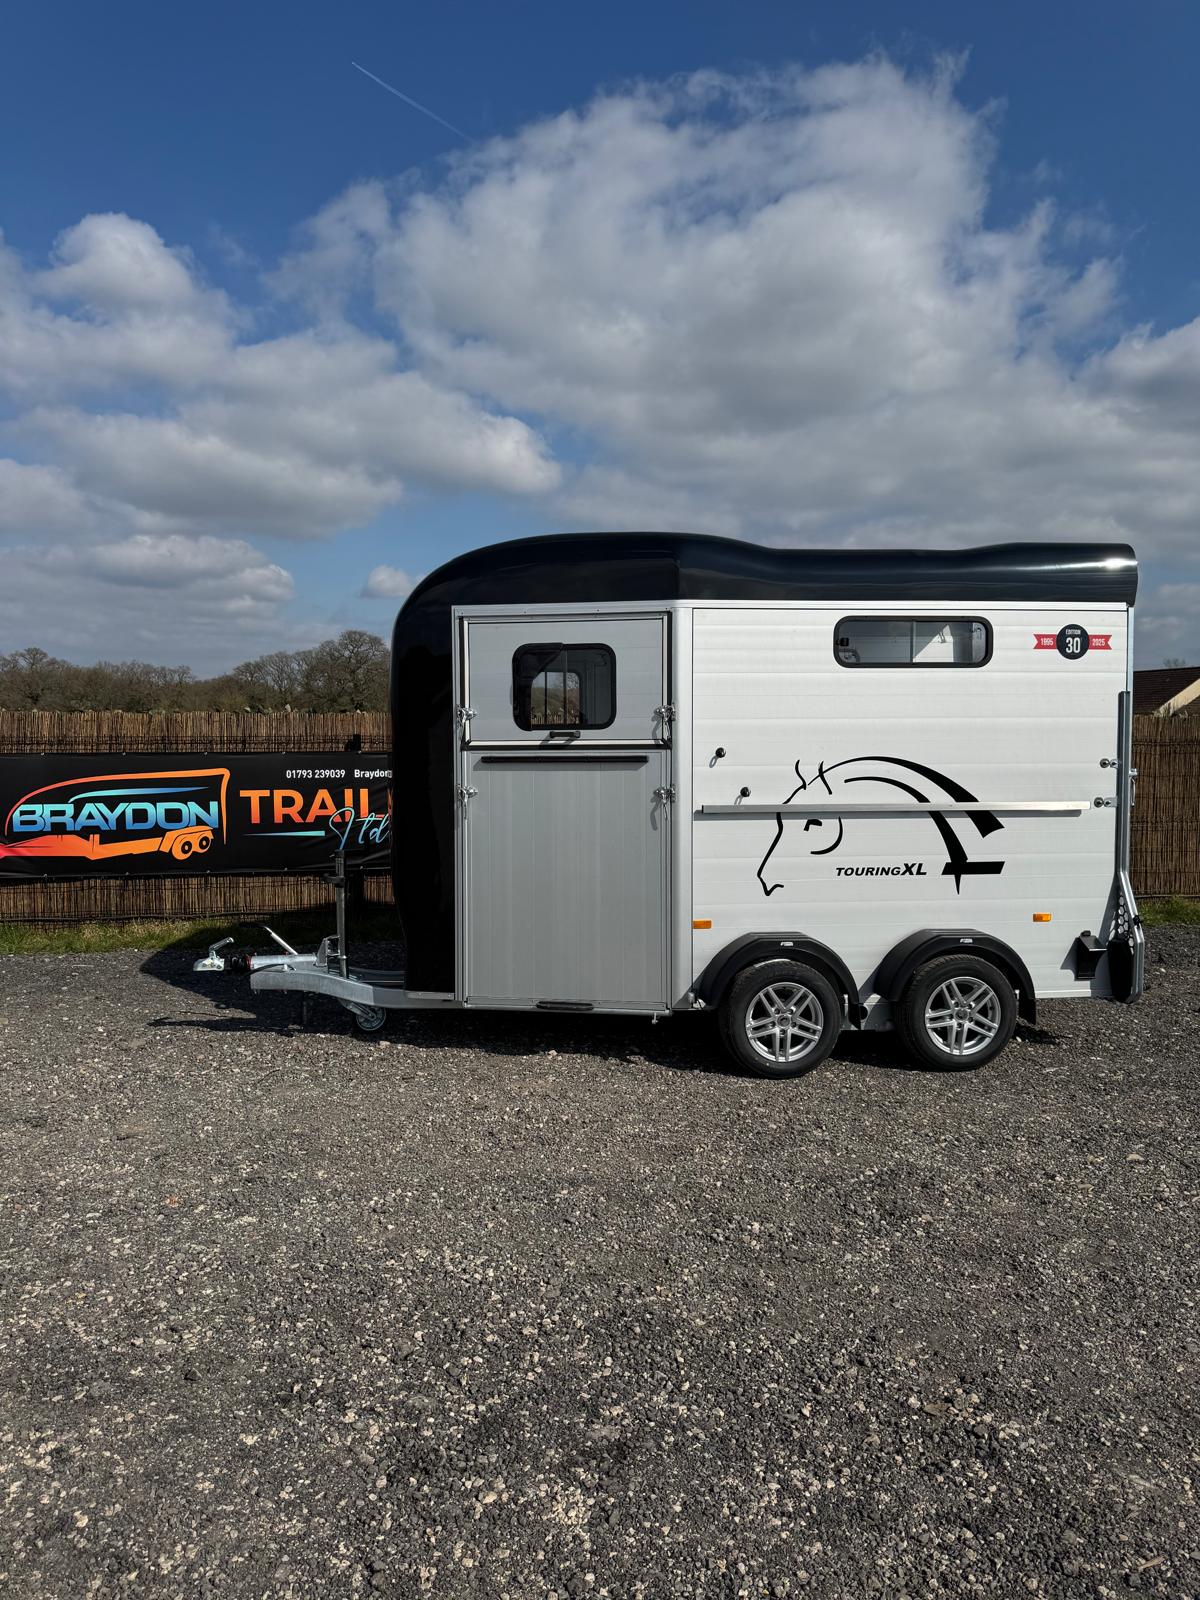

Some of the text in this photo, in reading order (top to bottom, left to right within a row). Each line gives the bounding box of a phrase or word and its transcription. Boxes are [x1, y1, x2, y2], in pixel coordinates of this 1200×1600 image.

[1040, 637, 1054, 646] 1995
[1065, 637, 1081, 653] 30
[1092, 638, 1105, 646] 2025
[286, 769, 312, 779] 01793
[314, 769, 346, 779] 239039
[13, 801, 219, 832] BRAYDON
